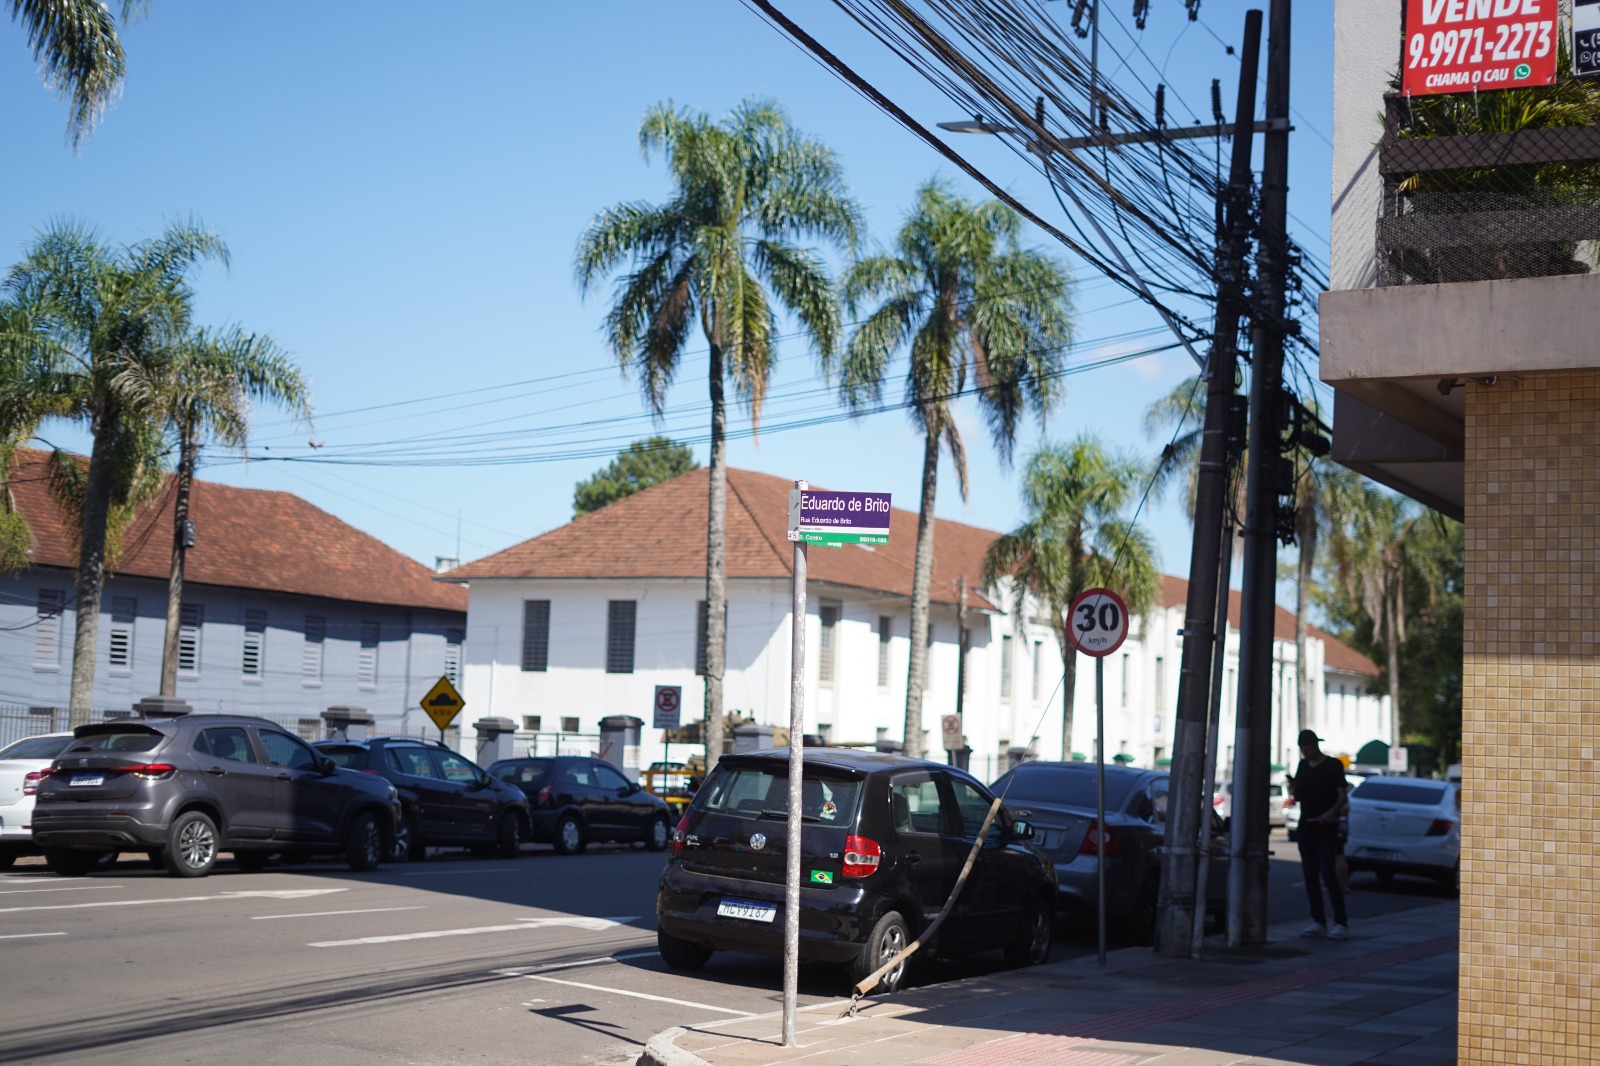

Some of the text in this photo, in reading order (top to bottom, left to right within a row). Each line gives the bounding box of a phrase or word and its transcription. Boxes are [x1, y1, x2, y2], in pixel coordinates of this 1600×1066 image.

[1408, 20, 1553, 69] 9.9971-2273
[1425, 68, 1509, 87] CHAMA O CAU
[801, 495, 890, 512] Eduardo de Brito
[811, 516, 832, 524] Eduardo
[1076, 603, 1119, 632] 30
[1088, 637, 1107, 645] km/h
